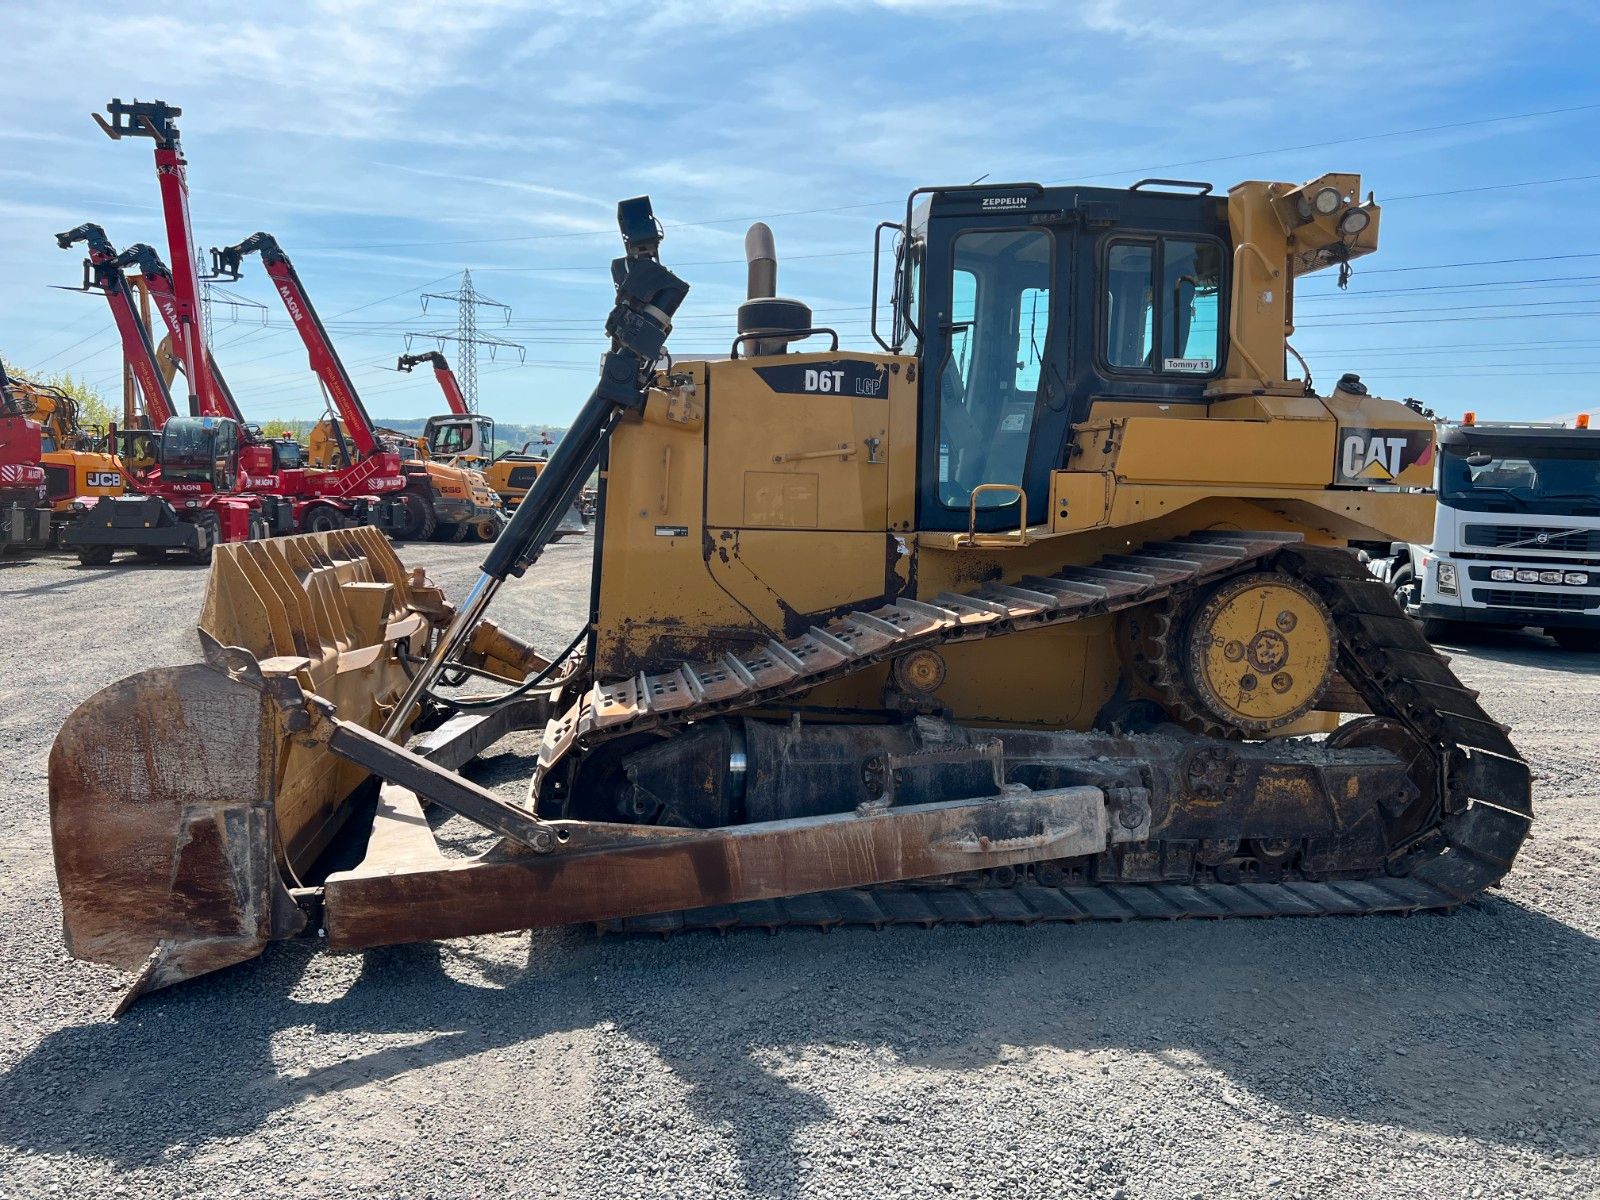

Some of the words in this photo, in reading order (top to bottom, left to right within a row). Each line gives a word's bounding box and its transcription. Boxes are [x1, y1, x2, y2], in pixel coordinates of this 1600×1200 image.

[982, 197, 1027, 205] ZEPPELIN
[280, 286, 303, 321] MAGNI
[1168, 360, 1197, 370] Tommy
[1200, 361, 1209, 369] 13
[805, 370, 844, 392] D6T
[856, 378, 880, 395] LGP
[1343, 436, 1407, 478] CAT
[88, 474, 120, 486] JCB
